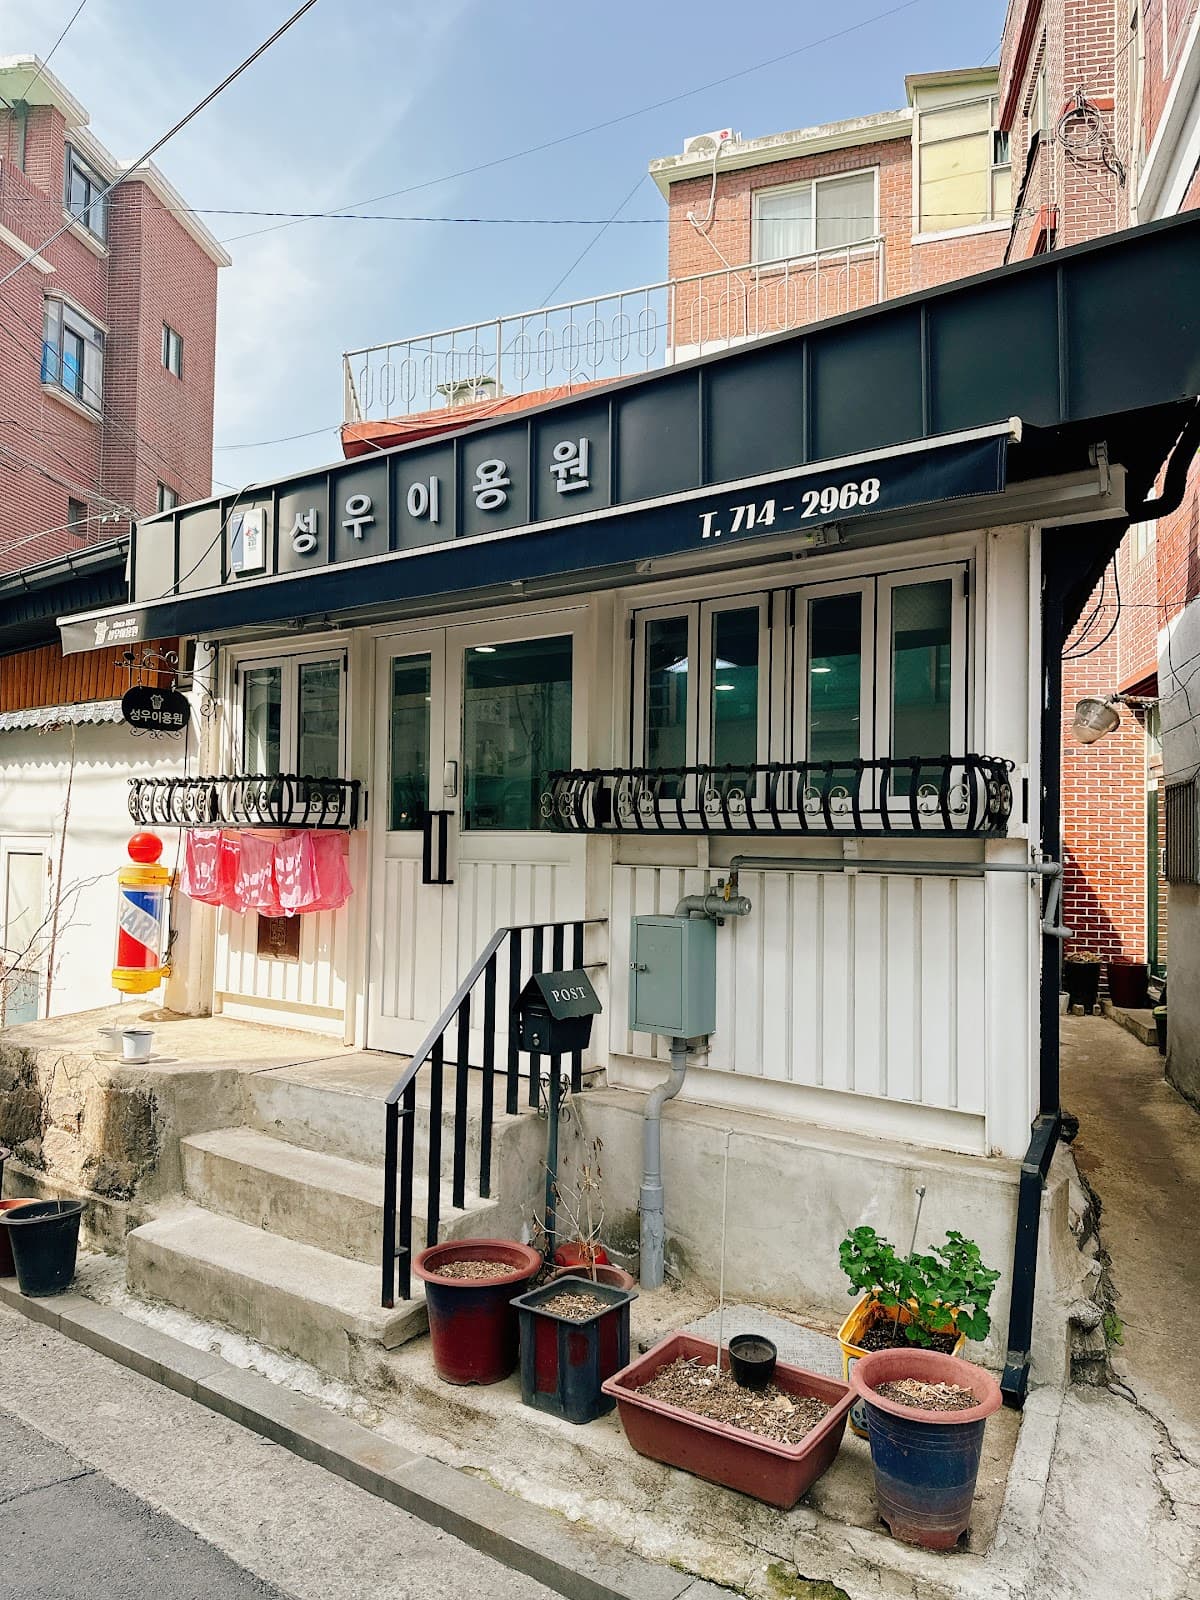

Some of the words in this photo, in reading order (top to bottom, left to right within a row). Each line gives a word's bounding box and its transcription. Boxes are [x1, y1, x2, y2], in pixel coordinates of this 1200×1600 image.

[289, 437, 590, 553] 성우이용원
[699, 511, 722, 538] T.
[729, 499, 776, 533] 714
[800, 478, 881, 519] 2968
[130, 708, 183, 725] 성우이용원
[551, 986, 587, 1003] POST
